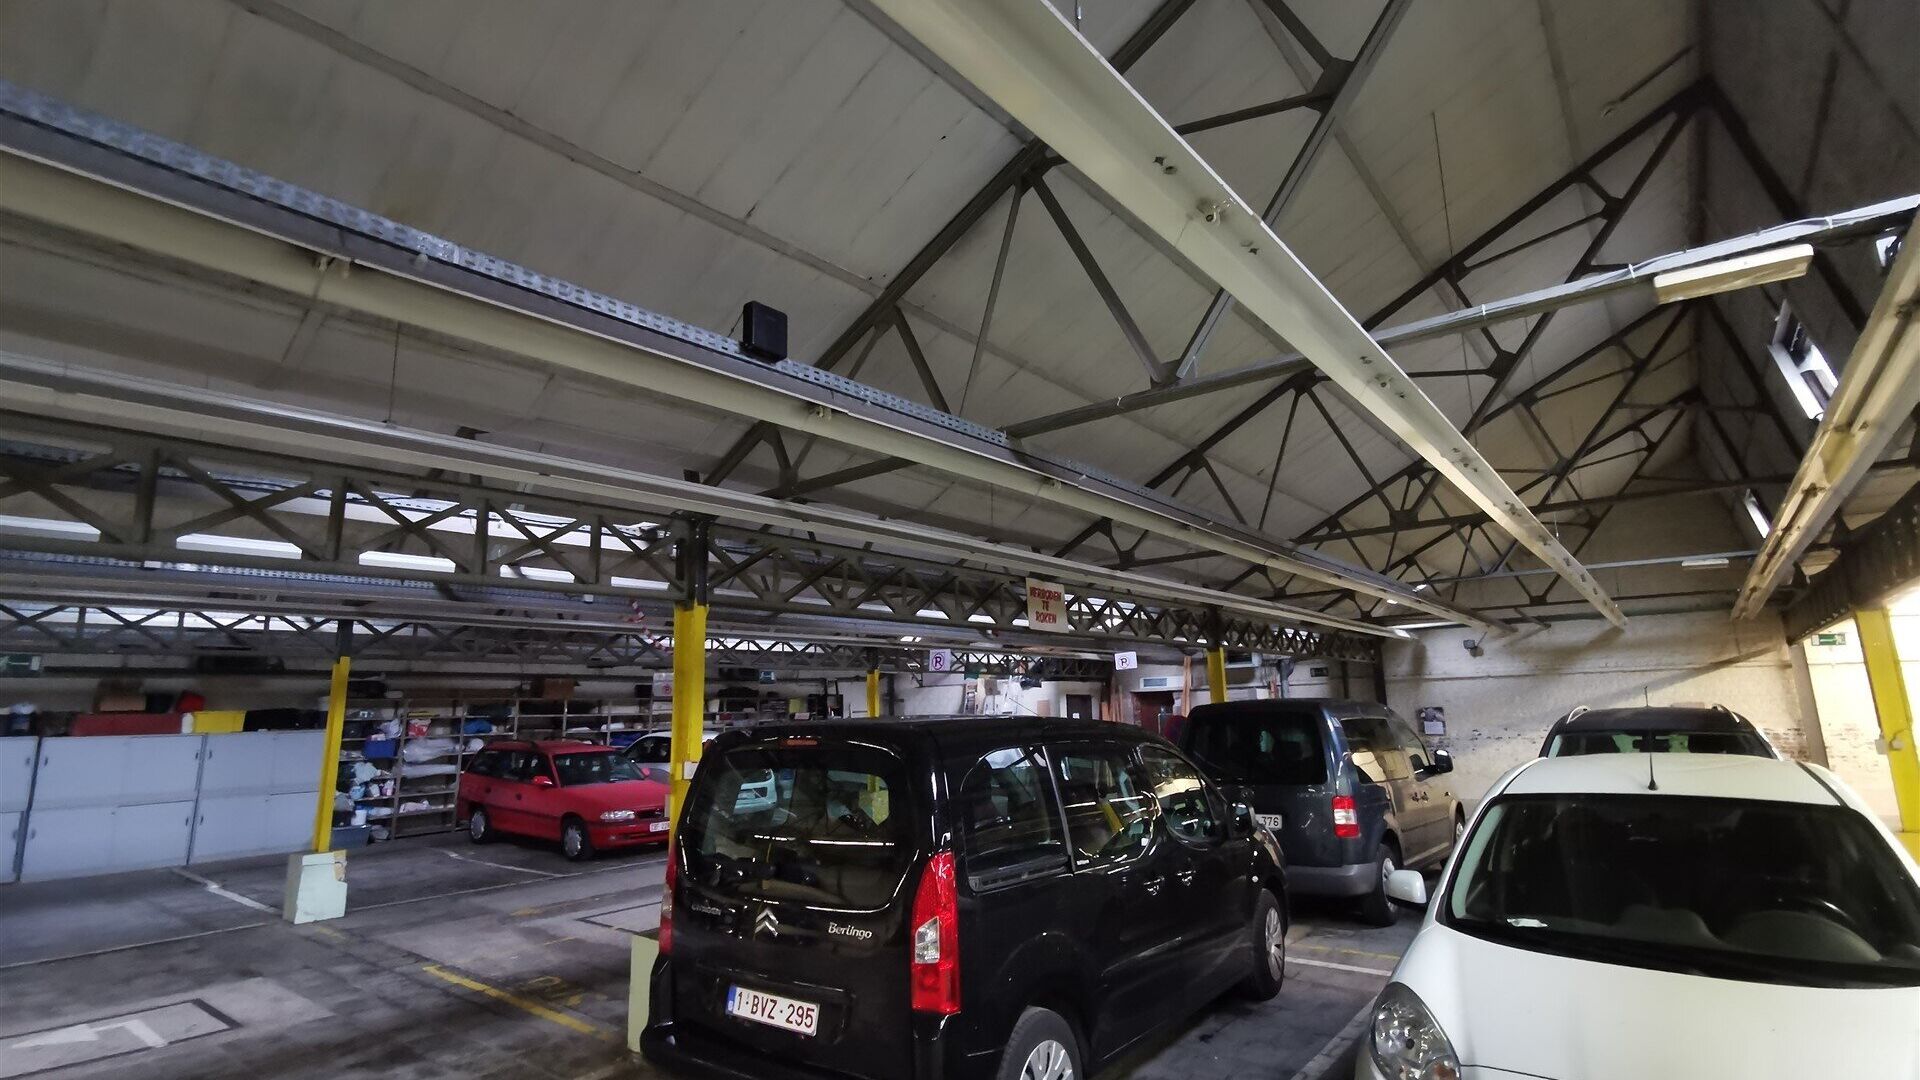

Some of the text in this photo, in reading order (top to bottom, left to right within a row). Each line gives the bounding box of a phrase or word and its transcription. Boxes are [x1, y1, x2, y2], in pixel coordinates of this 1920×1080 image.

[1041, 600, 1050, 611] TE
[1035, 610, 1057, 624] ROKEN
[828, 921, 872, 940] Berlingo
